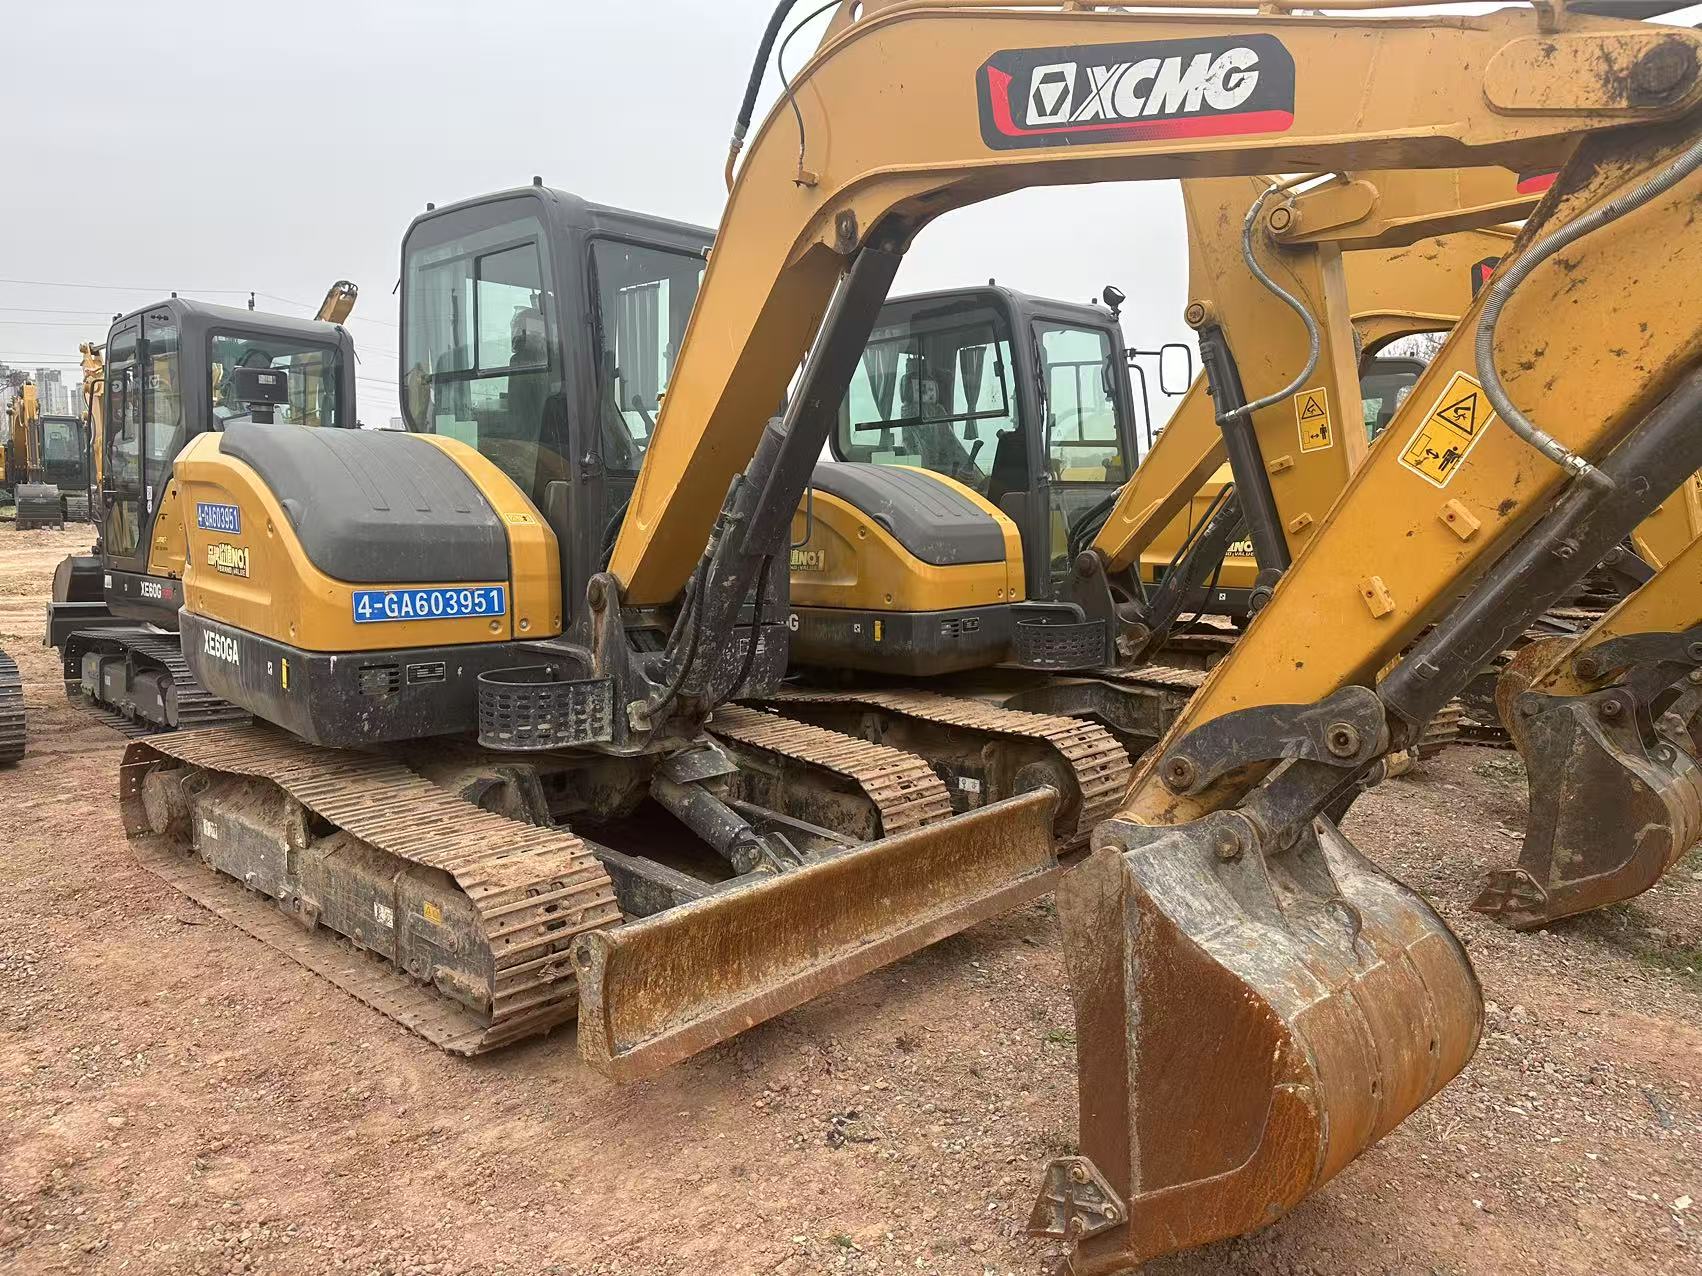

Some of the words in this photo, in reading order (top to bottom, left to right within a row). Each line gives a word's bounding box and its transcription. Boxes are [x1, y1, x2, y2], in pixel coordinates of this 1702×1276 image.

[1068, 47, 1260, 122] XCMG
[198, 505, 239, 530] 4-GA603951
[357, 589, 500, 618] 4-GA603951
[203, 629, 240, 666] XE60GA
